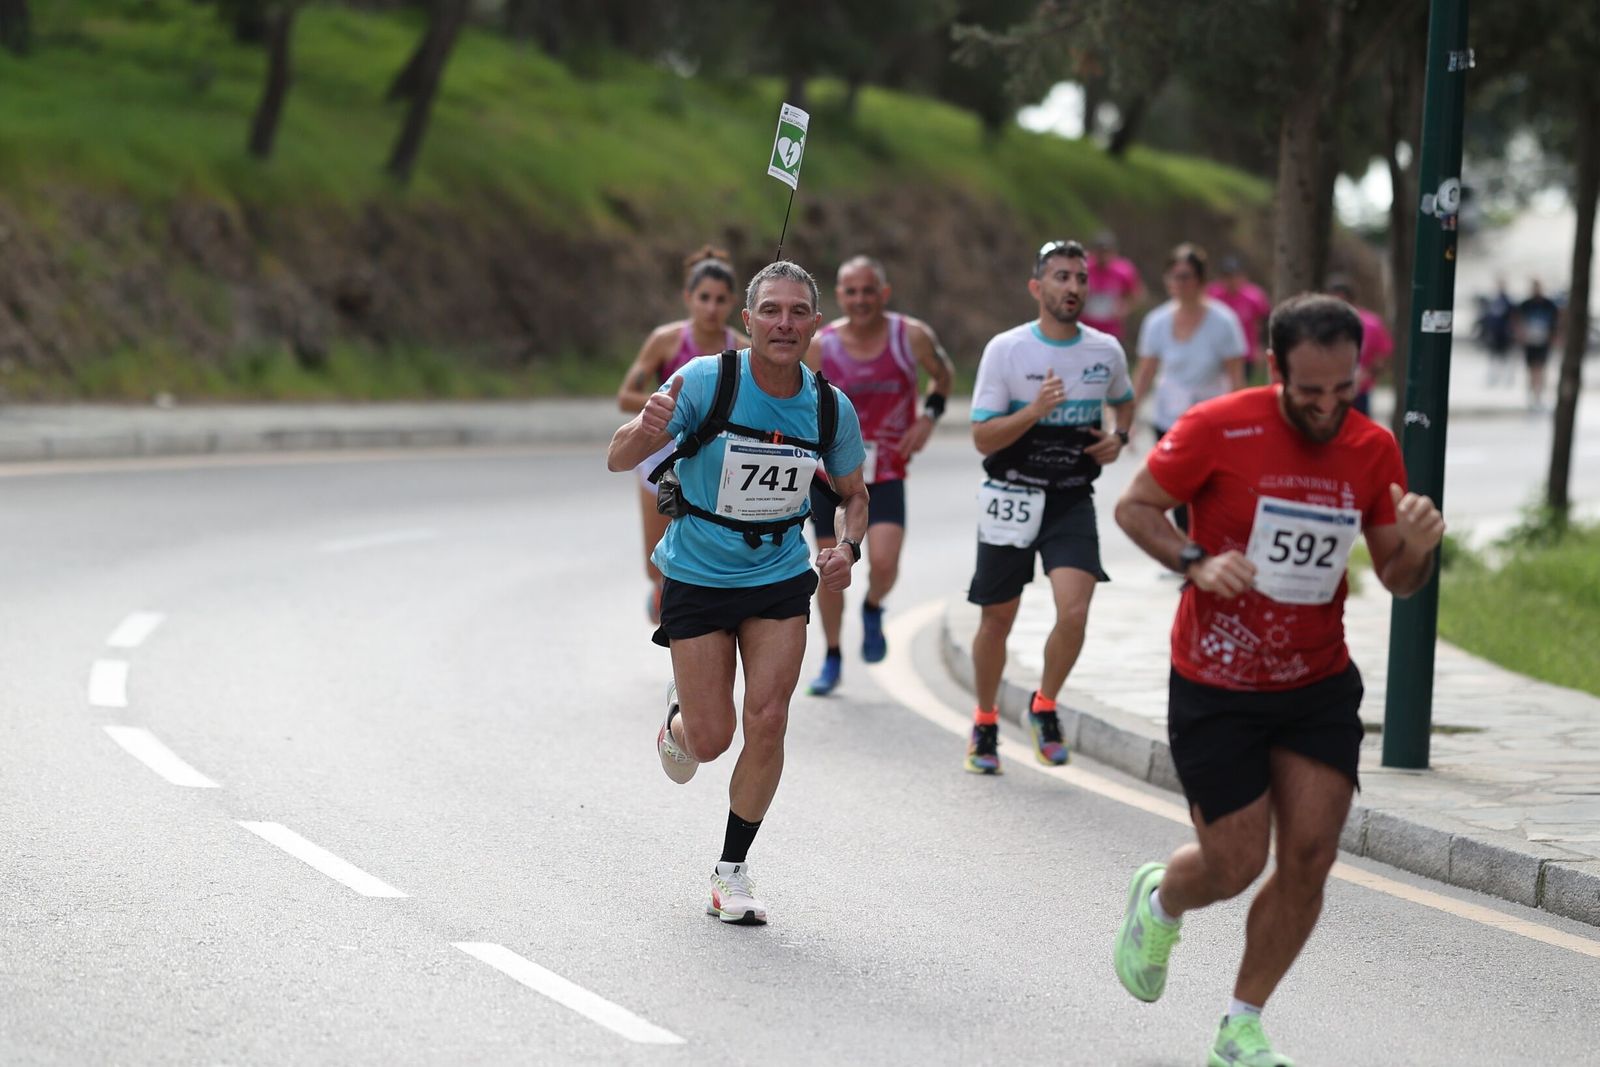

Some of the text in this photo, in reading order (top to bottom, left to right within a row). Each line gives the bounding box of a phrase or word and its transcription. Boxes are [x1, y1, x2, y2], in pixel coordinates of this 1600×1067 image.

[740, 464, 798, 491] 741
[986, 498, 1031, 523] 435
[1268, 530, 1338, 568] 592
